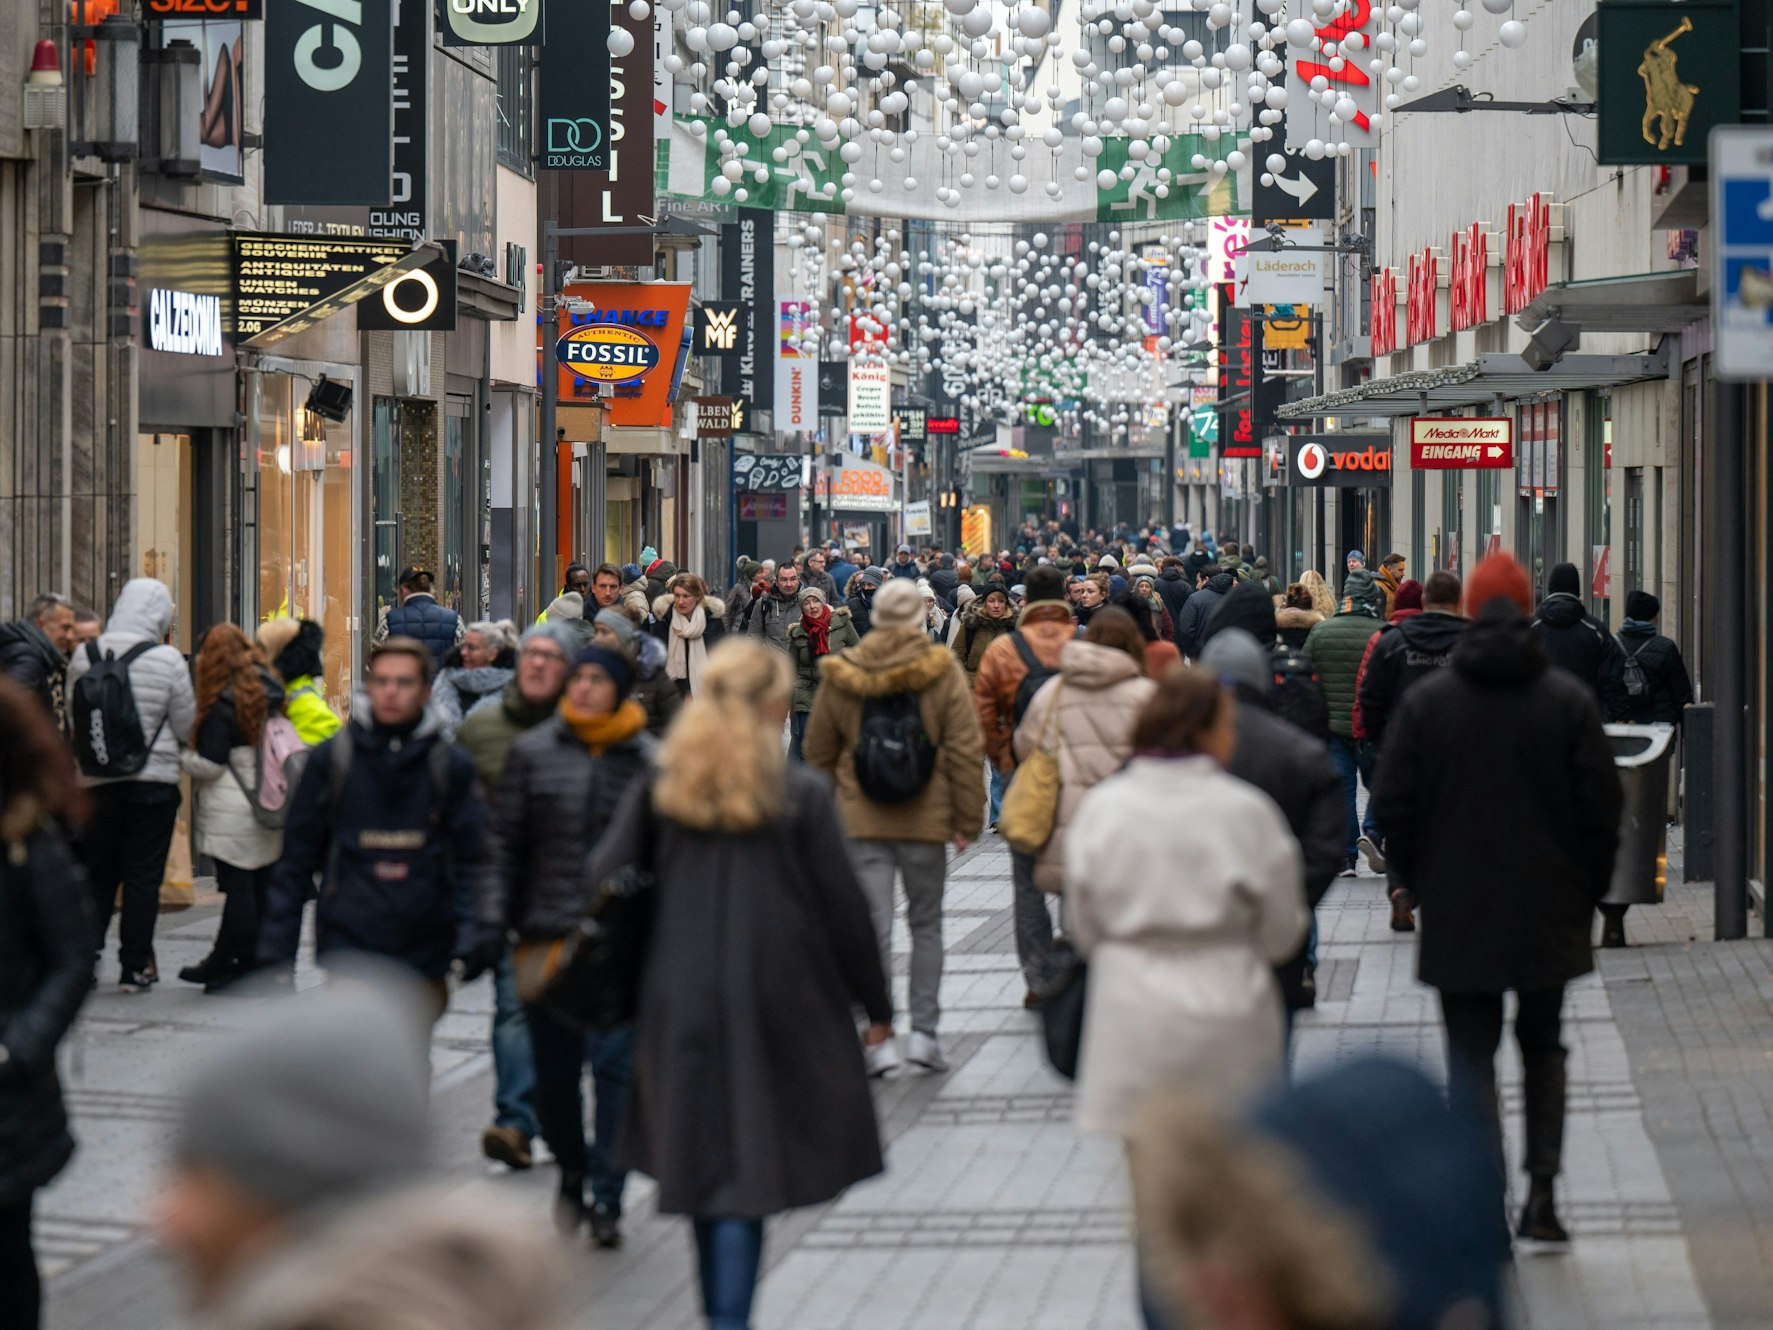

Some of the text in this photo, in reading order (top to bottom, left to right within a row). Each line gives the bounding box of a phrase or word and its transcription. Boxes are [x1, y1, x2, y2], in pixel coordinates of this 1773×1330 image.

[547, 155, 602, 167] DOUGLAS
[657, 200, 692, 213] Fine
[370, 212, 420, 226] OUNG
[369, 228, 425, 241] SHION
[240, 243, 404, 255] GESCHENKARTIKEL
[240, 250, 327, 259] SOUVENIR
[240, 261, 365, 273] ANTIQUITÄTEN
[1256, 260, 1316, 271] Läderach
[240, 268, 326, 278] ANTIQUES
[239, 279, 298, 288] UHREN
[239, 286, 320, 296] WATCHES
[238, 298, 310, 308] MÜNZEN
[238, 306, 291, 315] COINS
[150, 288, 223, 356] CALZEDONIA
[577, 329, 641, 343] AUTHENTIC
[567, 343, 648, 364] FOSSIL
[852, 371, 887, 382] König
[697, 405, 731, 417] LBEN
[1423, 427, 1500, 439] Media Markt
[1332, 445, 1391, 472] voda
[1421, 445, 1481, 460] EINGANG
[841, 469, 883, 483] FOOD
[89, 708, 110, 765] adidas
